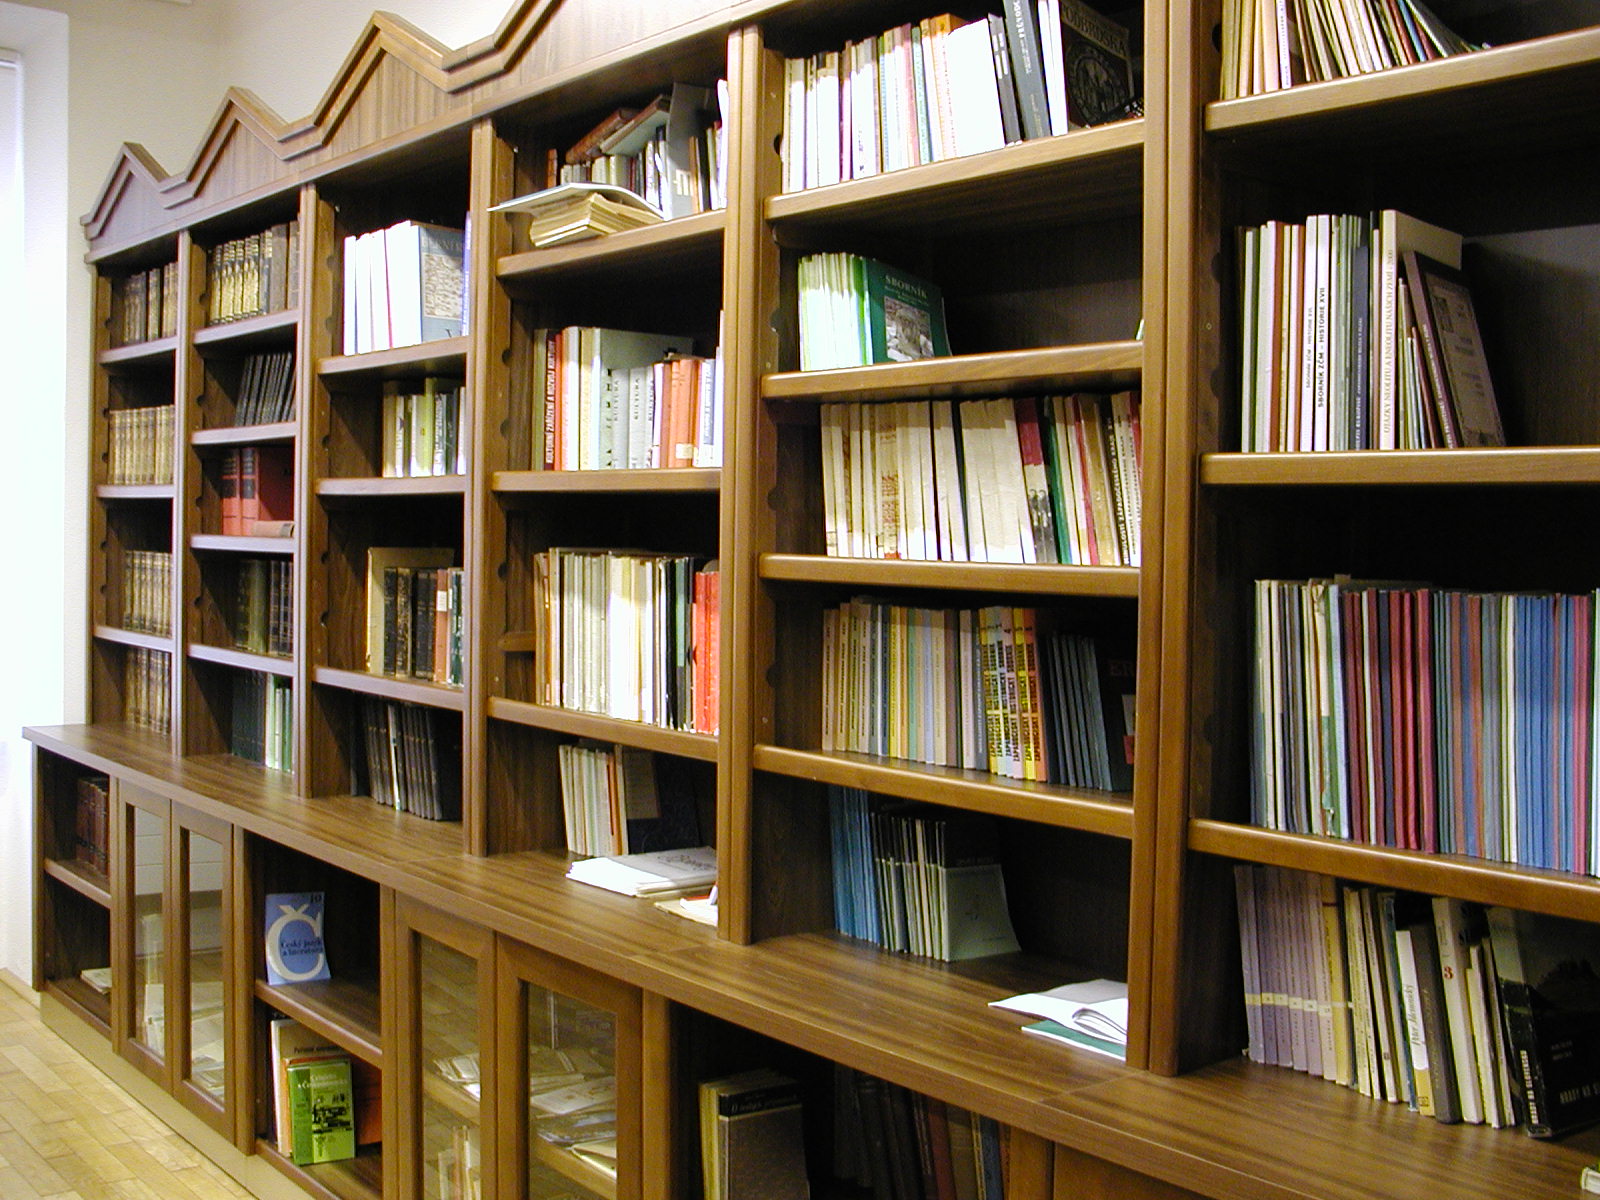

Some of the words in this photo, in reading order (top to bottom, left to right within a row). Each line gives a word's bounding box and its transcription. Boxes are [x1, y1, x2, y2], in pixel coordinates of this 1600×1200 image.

[1318, 306, 1326, 343] HISTORIE
[1317, 352, 1326, 369] ZČM
[1317, 371, 1326, 408] SBORNÍK
[1382, 402, 1392, 434] OTÁZKY
[310, 894, 322, 904] 10
[266, 904, 324, 981] Č
[280, 939, 302, 948] Český
[303, 937, 322, 948] jazyk
[1443, 966, 1453, 980] 3
